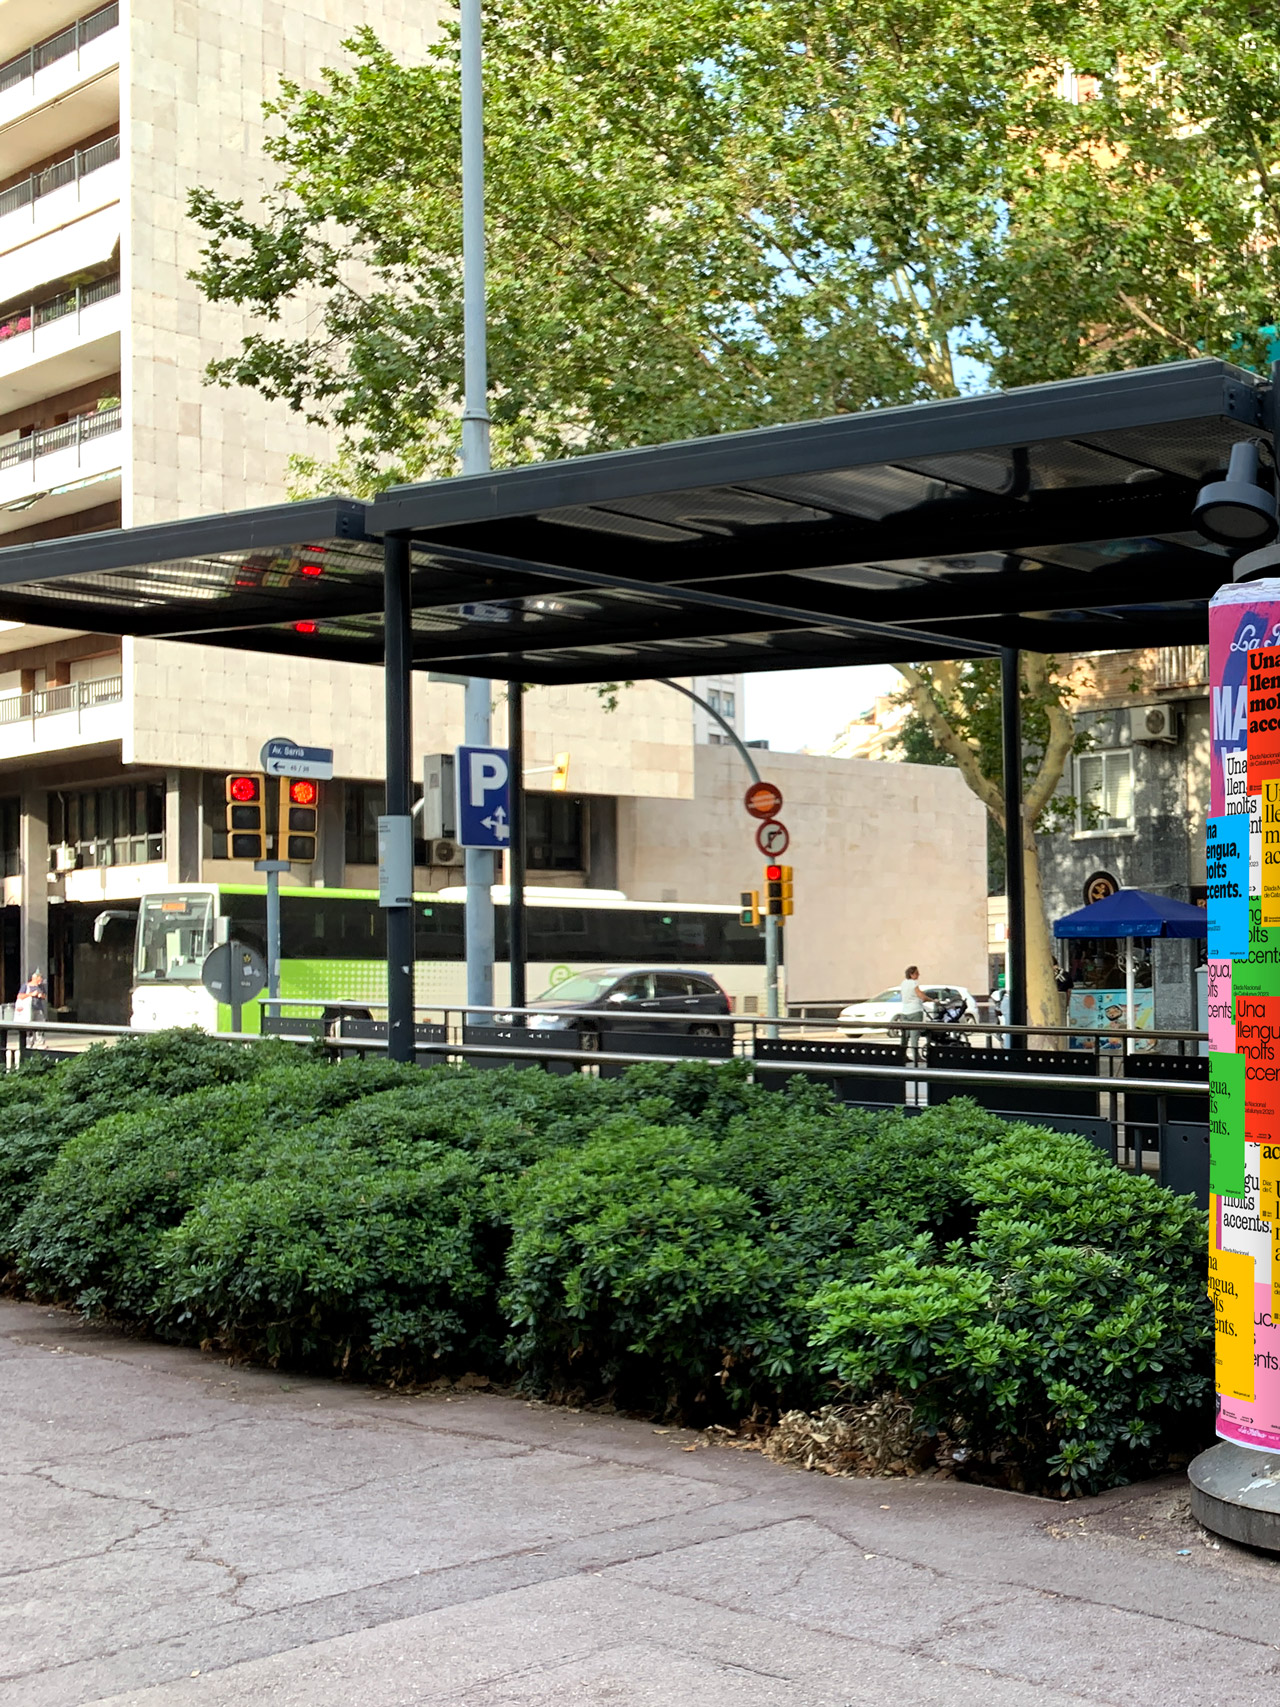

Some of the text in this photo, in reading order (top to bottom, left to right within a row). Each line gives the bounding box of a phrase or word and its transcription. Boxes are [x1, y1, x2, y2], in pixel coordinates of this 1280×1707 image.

[1227, 757, 1247, 776] Una
[470, 752, 508, 807] P
[1227, 797, 1257, 816] molts
[1237, 1000, 1265, 1018] Una
[1237, 1043, 1275, 1060] molts
[1223, 1195, 1255, 1211] molts
[1223, 1213, 1272, 1234] accents.
